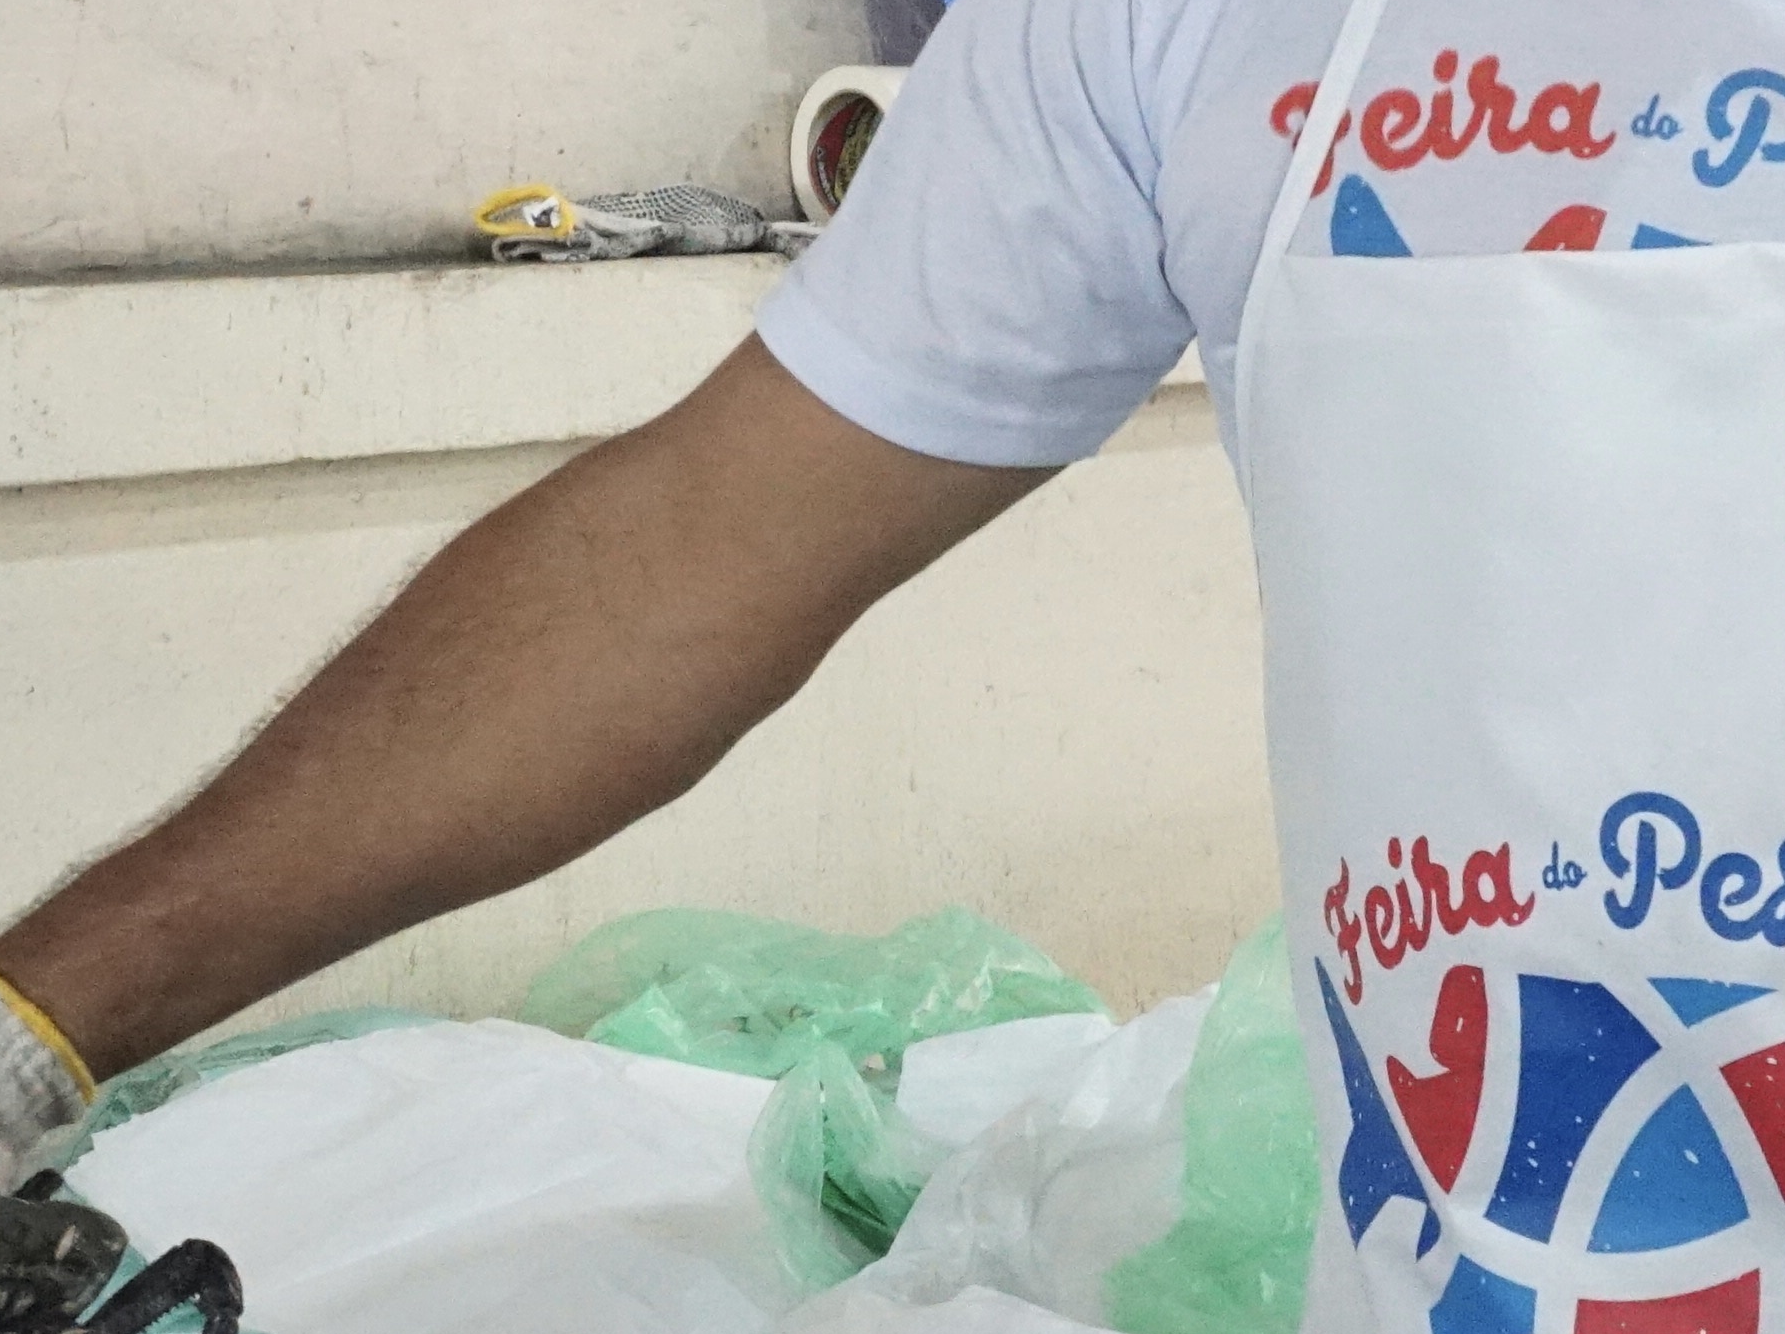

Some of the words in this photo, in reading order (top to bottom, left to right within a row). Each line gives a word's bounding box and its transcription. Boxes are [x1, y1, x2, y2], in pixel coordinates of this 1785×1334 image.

[1631, 93, 1682, 140] do
[1323, 835, 1535, 1006] Feira
[1542, 841, 1588, 892] do
